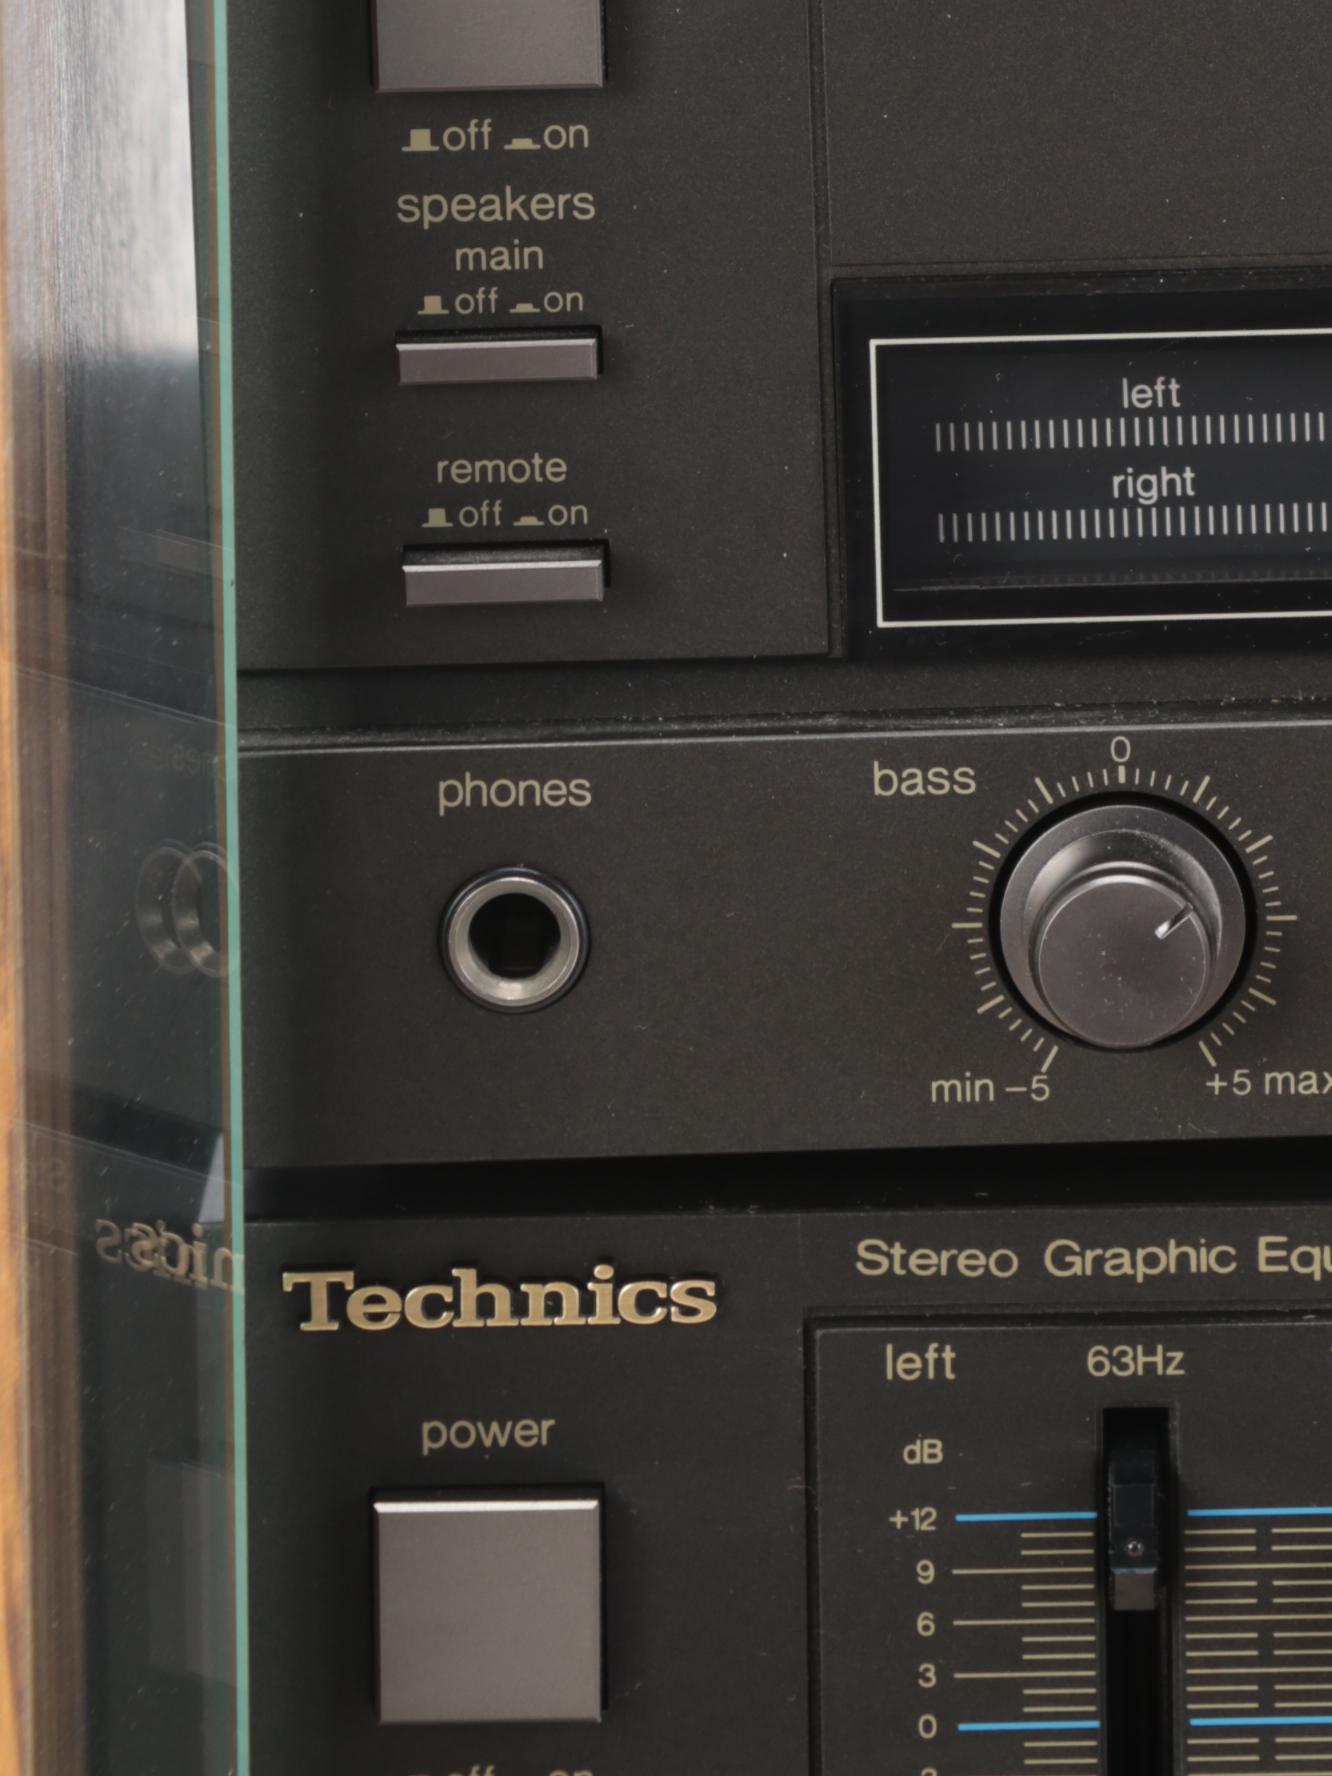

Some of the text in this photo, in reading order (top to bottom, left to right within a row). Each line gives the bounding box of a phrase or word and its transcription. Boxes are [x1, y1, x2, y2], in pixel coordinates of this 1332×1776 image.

[442, 118, 589, 152] off on
[397, 185, 596, 230] speakers
[455, 238, 544, 271] main
[454, 286, 584, 315] off on
[1122, 376, 1181, 409] left
[437, 452, 568, 484] remote
[1112, 466, 1195, 505] right
[458, 499, 588, 528] off on
[1110, 735, 1131, 763] 0
[438, 771, 592, 816] phones
[873, 760, 977, 797] bass
[931, 1071, 995, 1103] min
[1205, 1068, 1252, 1096] +5
[855, 1238, 1019, 1278] Stereo
[1044, 1238, 1238, 1284] Graphic
[282, 1264, 718, 1332] Technics
[885, 1342, 956, 1381] left
[1087, 1343, 1185, 1377] 63Hz
[422, 1418, 556, 1456] power
[902, 1438, 944, 1465] dB
[889, 1506, 937, 1531] +12
[916, 1559, 935, 1585] 9
[916, 1611, 936, 1637] 6
[918, 1663, 937, 1688] 3
[917, 1713, 938, 1739] 0
